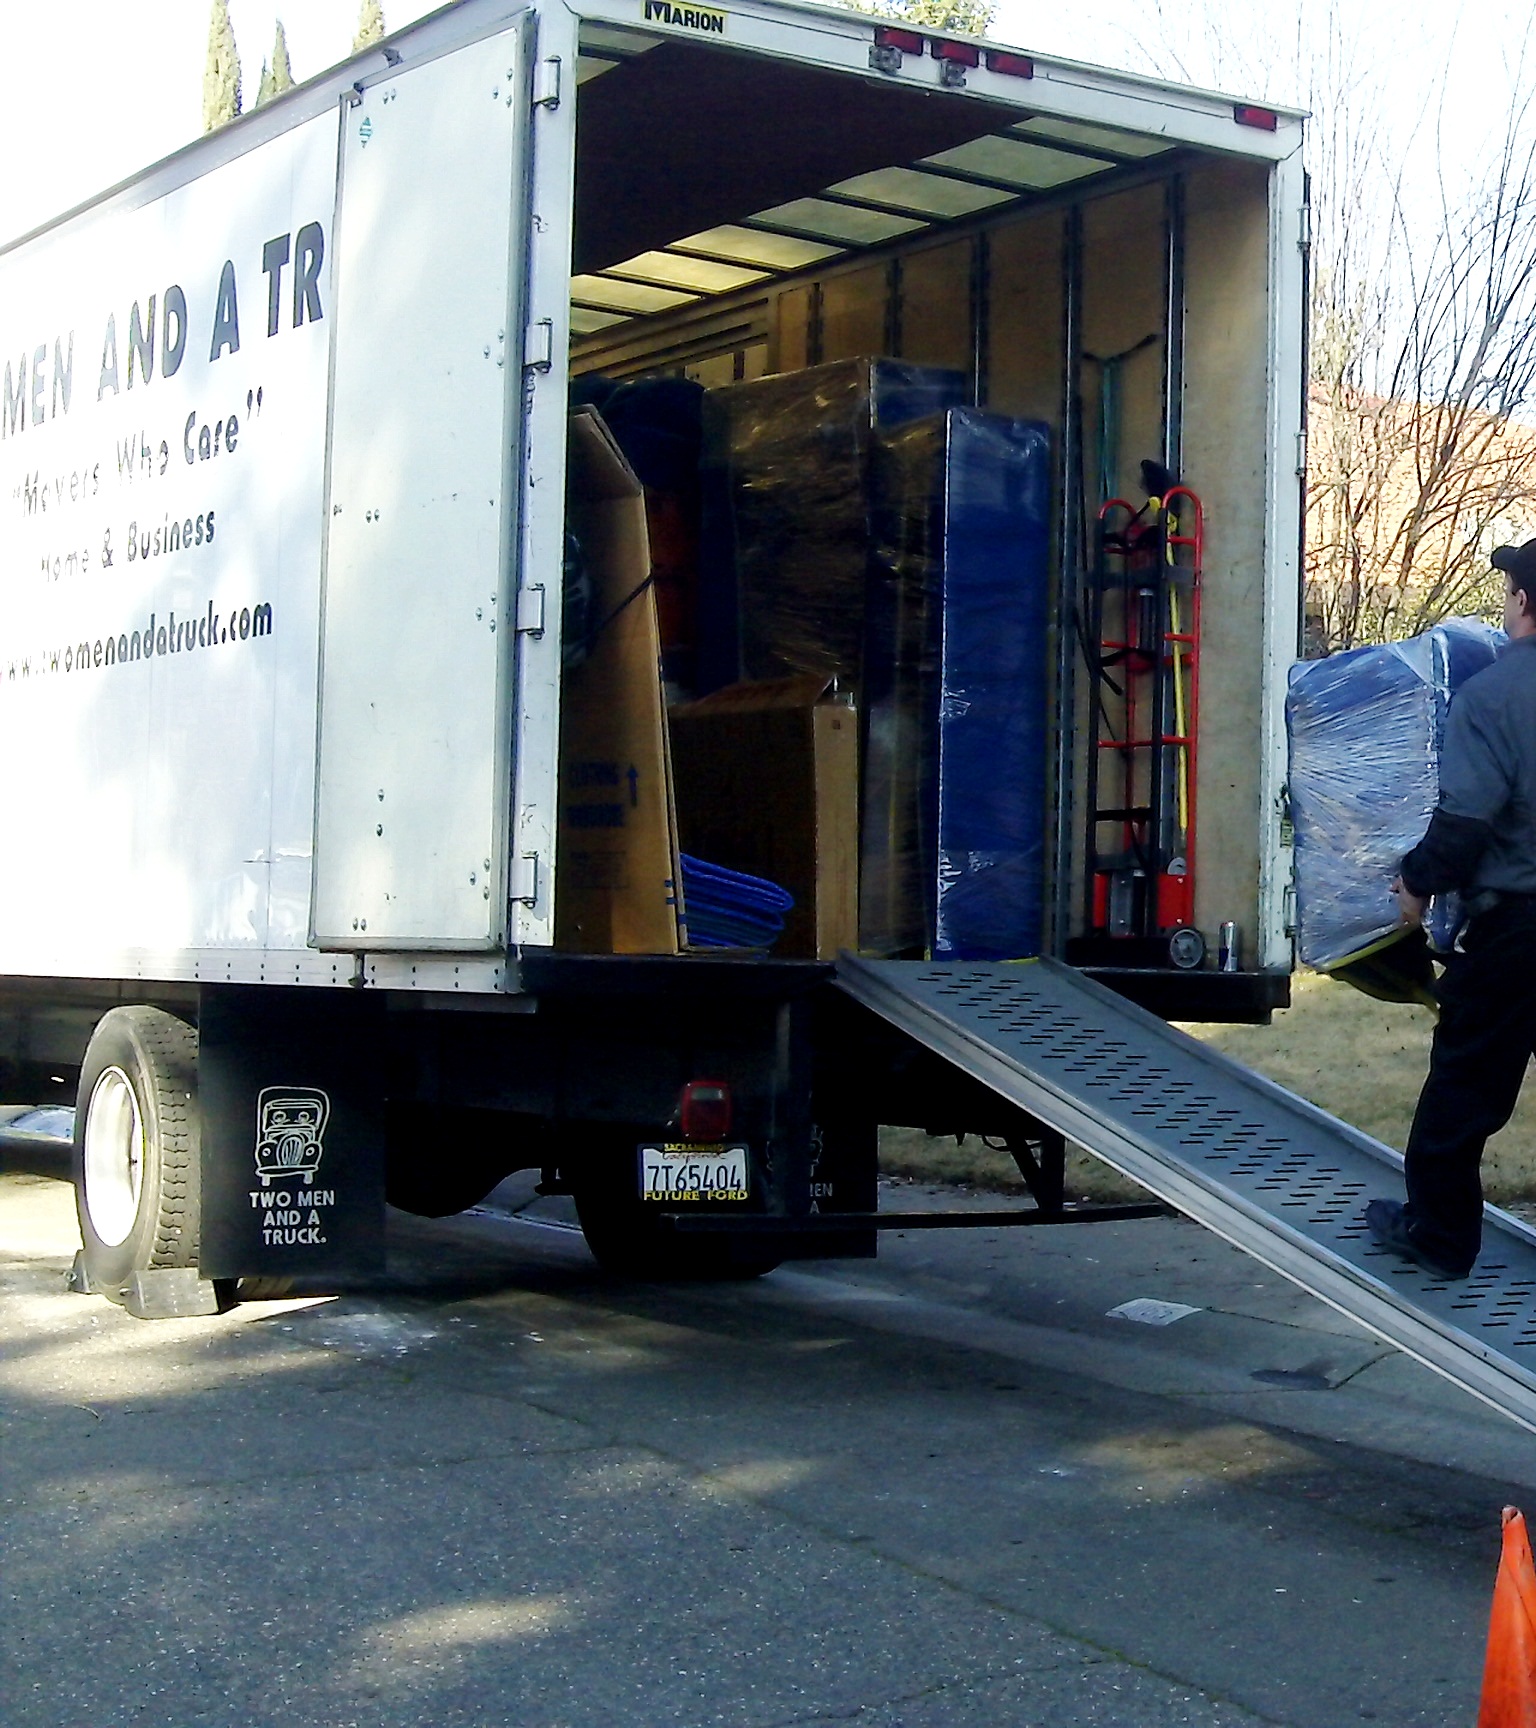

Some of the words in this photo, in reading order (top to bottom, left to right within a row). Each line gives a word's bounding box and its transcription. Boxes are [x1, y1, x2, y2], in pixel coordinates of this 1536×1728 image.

[644, 0, 725, 34] MARION
[2, 329, 74, 440] MEN
[97, 284, 188, 402] AND
[209, 259, 240, 363] A
[262, 221, 325, 338] TR
[116, 430, 169, 486] Who
[102, 527, 114, 568] &
[127, 511, 215, 562] Business
[647, 1164, 741, 1191] 7T65404
[809, 1182, 833, 1197] EN
[249, 1191, 292, 1208] TWO
[297, 1189, 335, 1207] MEN
[644, 1190, 700, 1201] FUTURE
[707, 1190, 748, 1201] FORD
[263, 1210, 301, 1227] AND
[307, 1209, 320, 1225] A
